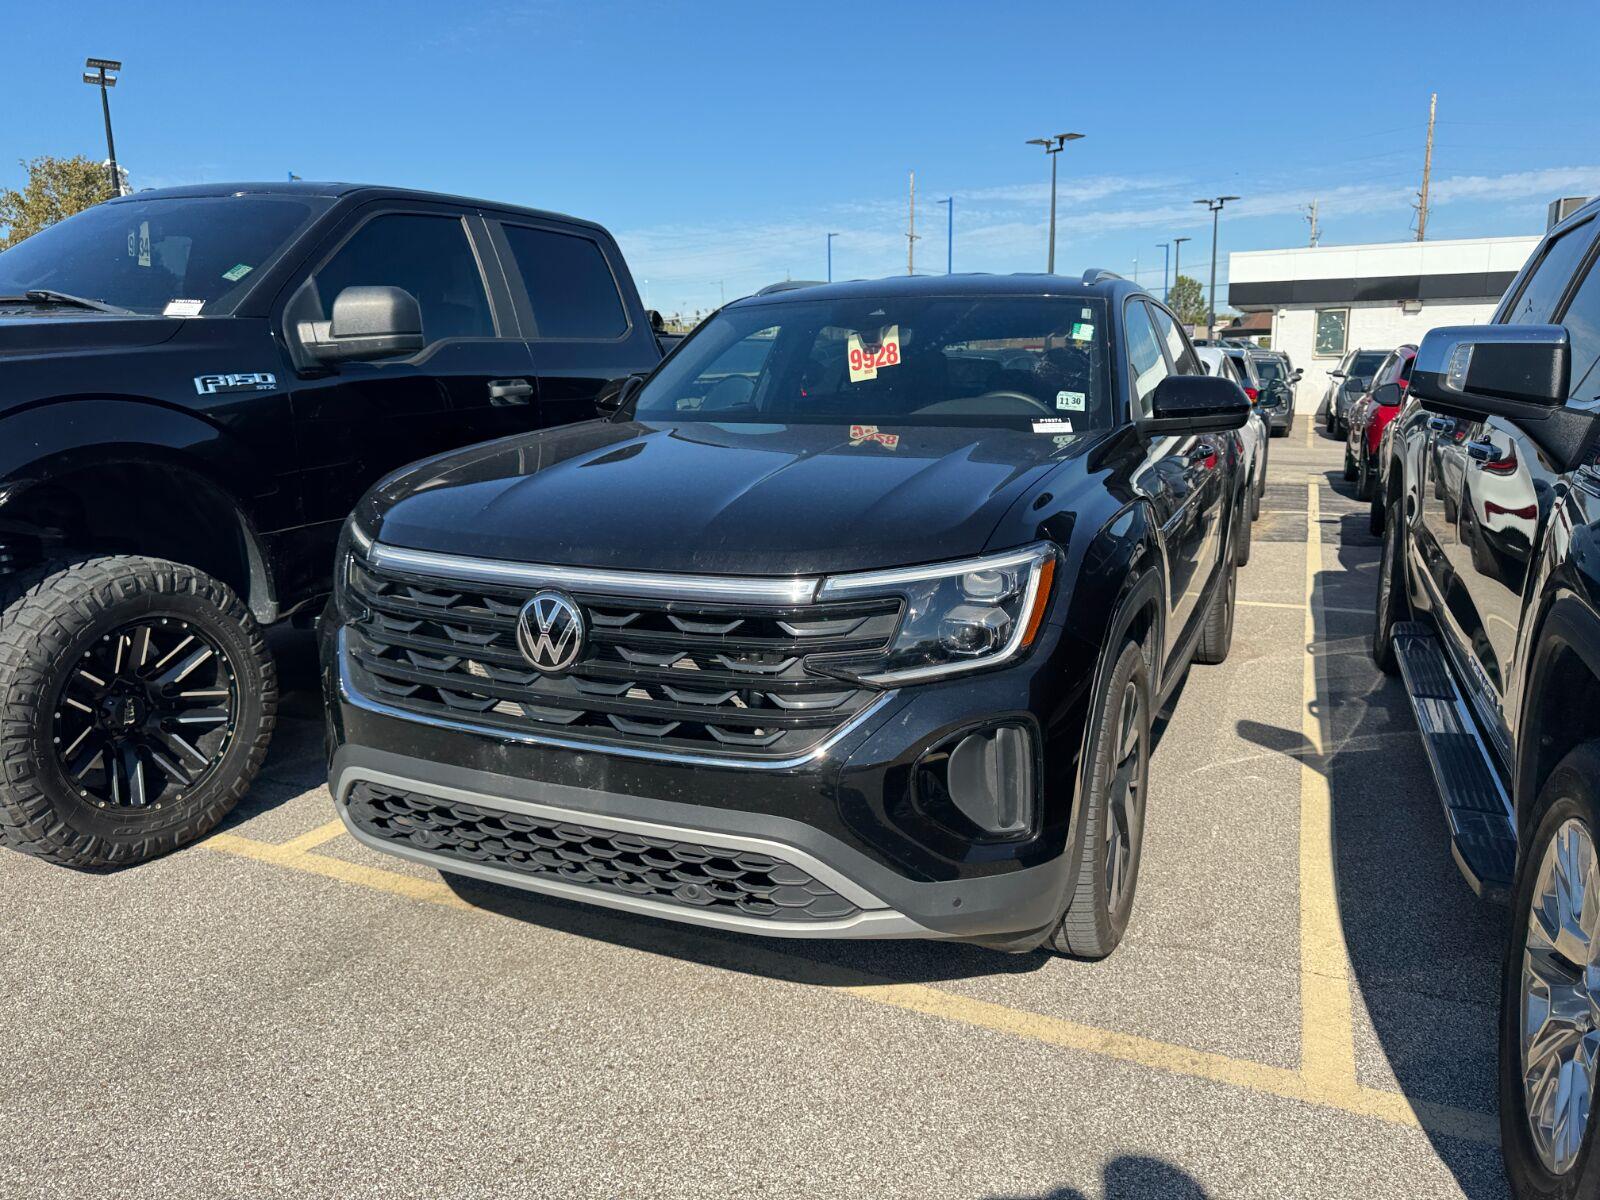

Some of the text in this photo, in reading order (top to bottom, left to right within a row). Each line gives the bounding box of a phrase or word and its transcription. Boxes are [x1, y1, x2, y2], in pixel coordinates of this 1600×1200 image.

[850, 342, 898, 371] 9928
[1060, 397, 1081, 405] 11 30
[519, 596, 578, 666] VW
